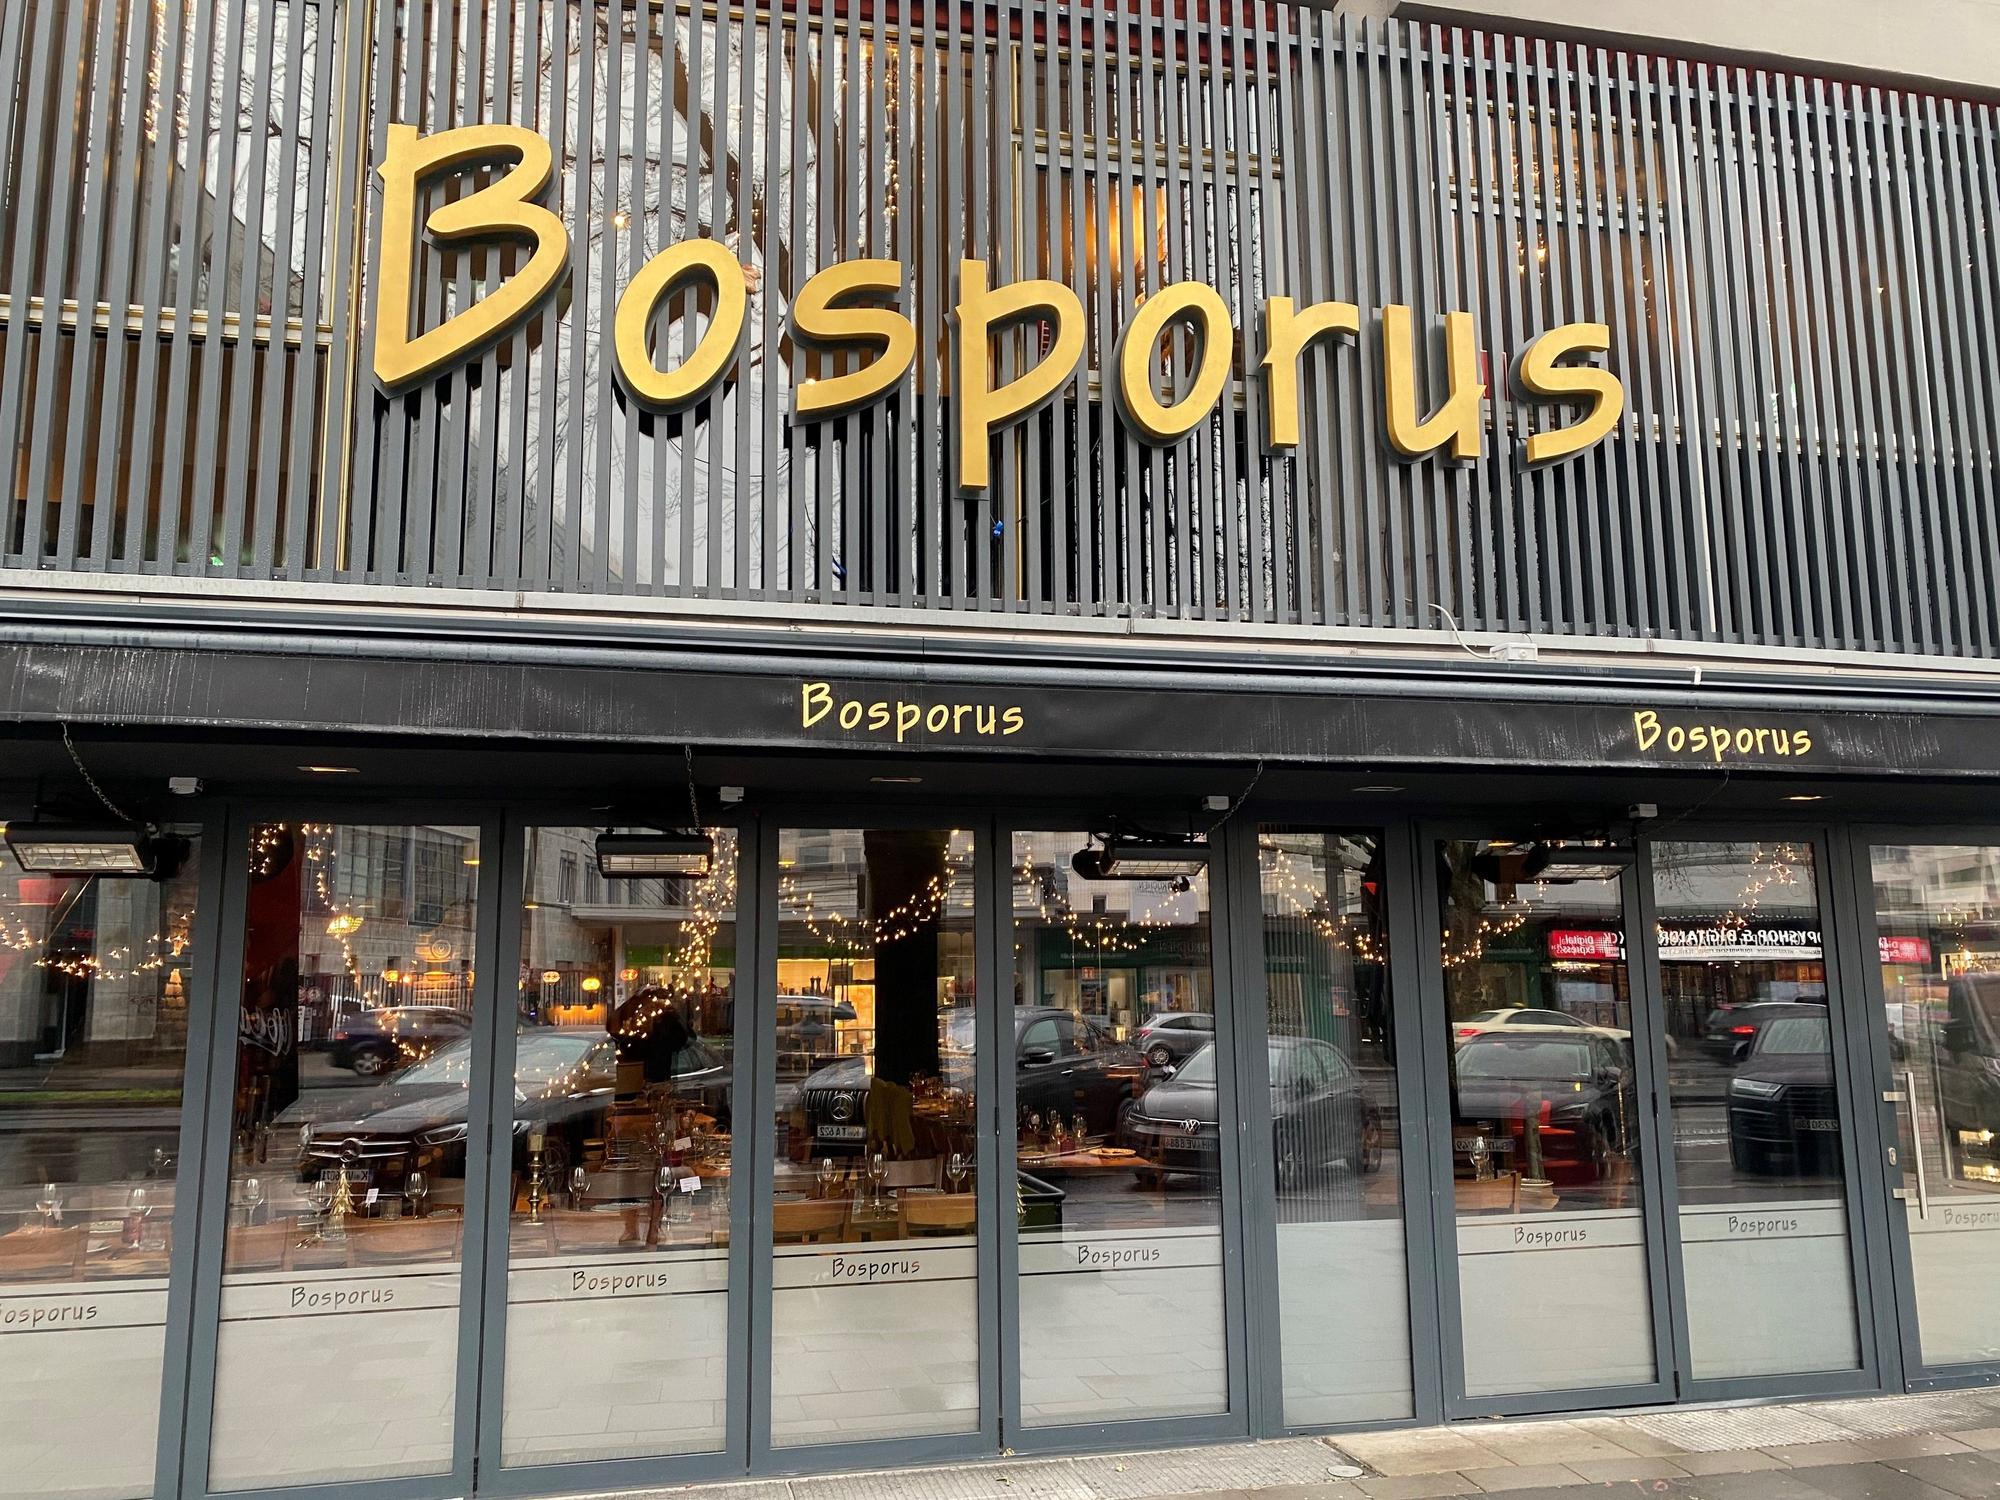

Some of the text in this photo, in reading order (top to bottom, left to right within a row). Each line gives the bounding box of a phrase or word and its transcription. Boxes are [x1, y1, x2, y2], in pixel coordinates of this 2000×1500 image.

[374, 122, 1625, 491] Bosporus
[801, 681, 1025, 743] Bosporus
[1633, 710, 1812, 762] Bosporus
[1513, 1226, 1587, 1247] Bosporus
[1728, 1215, 1799, 1237] Bosporus
[1078, 1245, 1160, 1267] Bosporus
[832, 1257, 921, 1281] Bosporus
[572, 1270, 668, 1294] Bosporus
[291, 1286, 394, 1310] Bosporus
